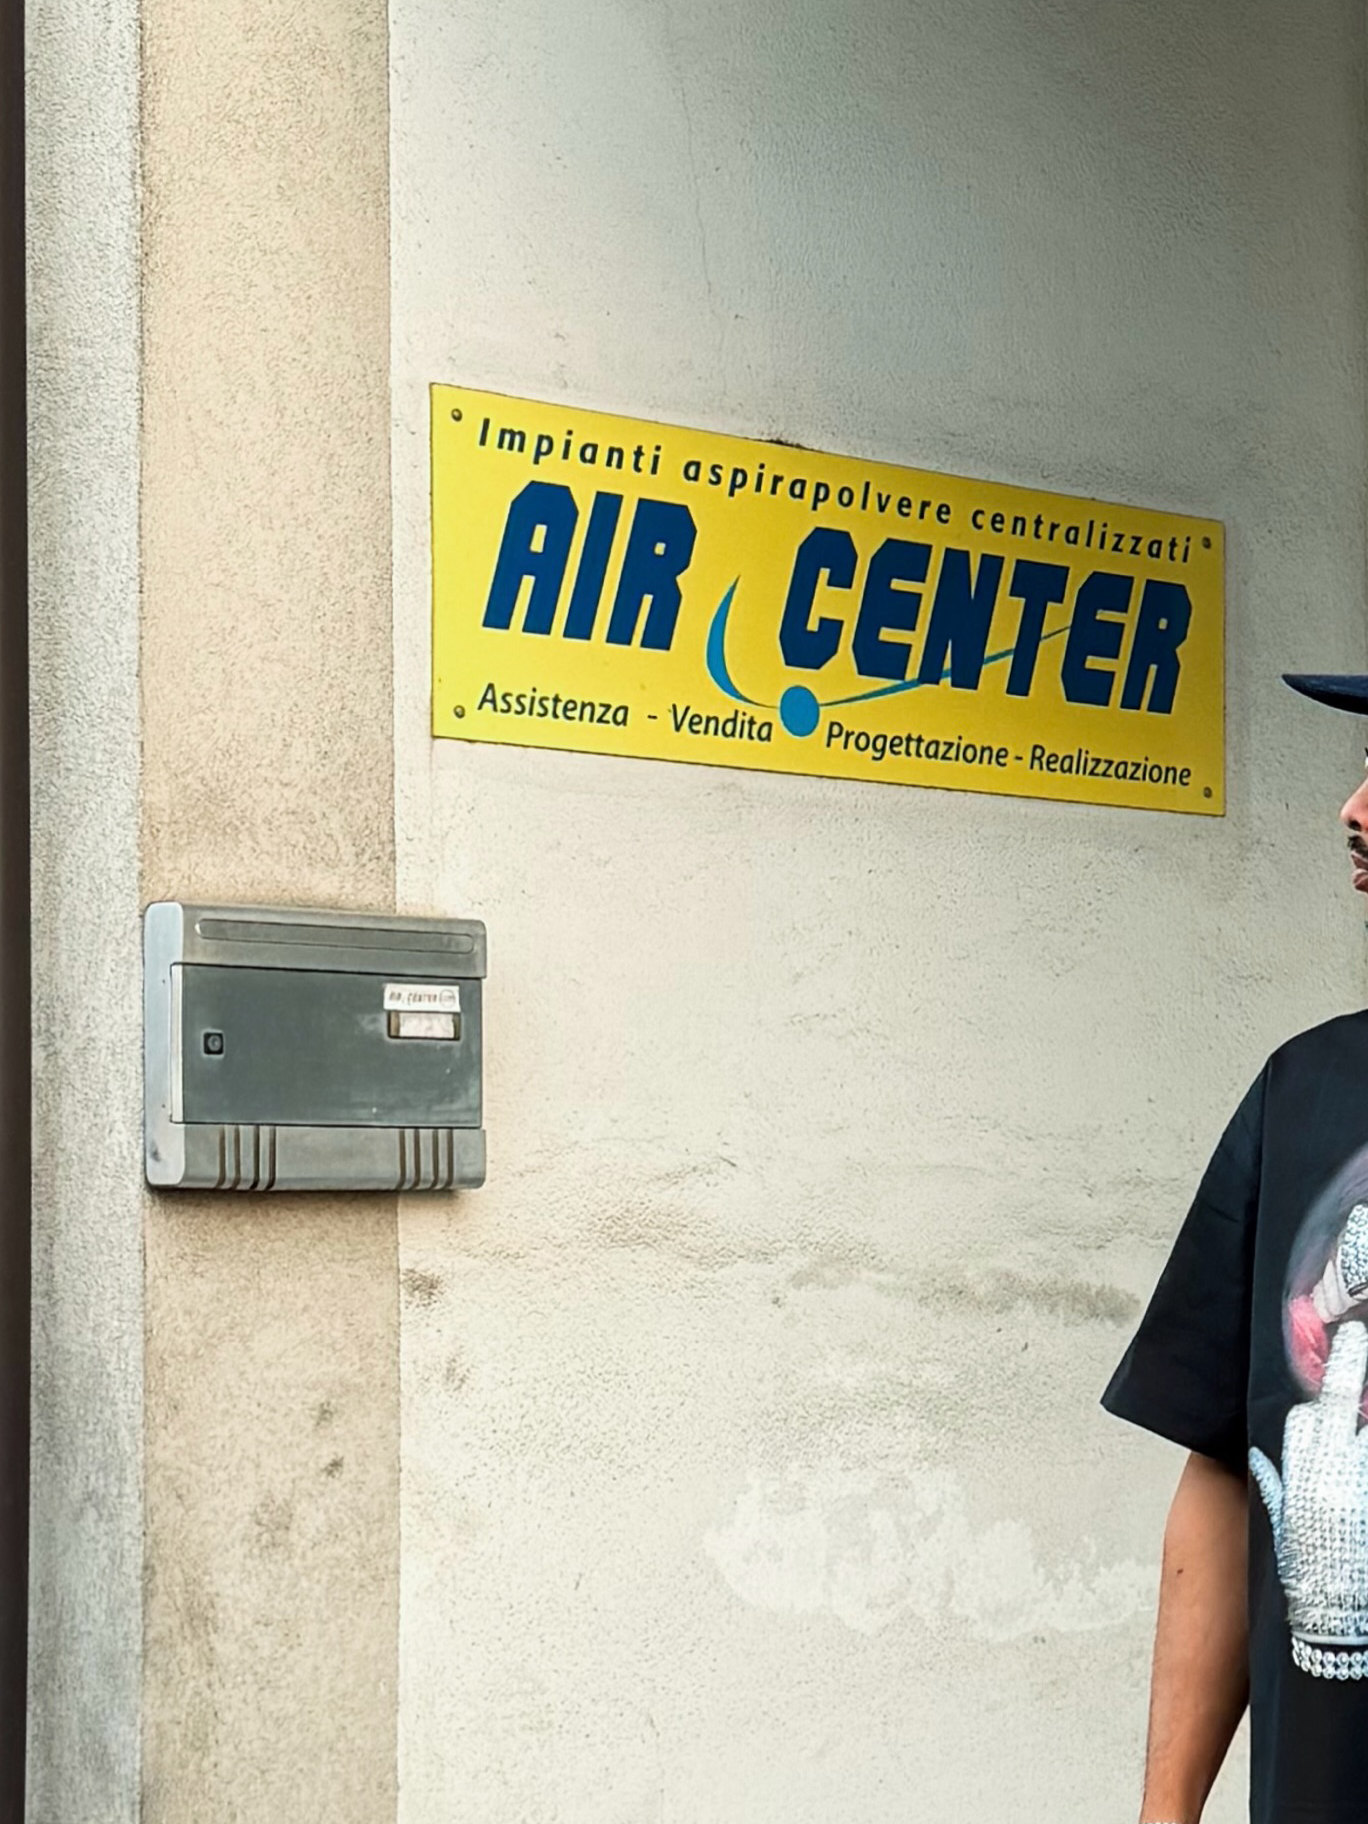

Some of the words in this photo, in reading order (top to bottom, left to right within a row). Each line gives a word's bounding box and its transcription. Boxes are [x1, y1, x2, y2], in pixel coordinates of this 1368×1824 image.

[479, 417, 661, 476] Impianti
[683, 460, 953, 526] aspirapolvere
[971, 509, 1193, 564] centralizzati
[482, 480, 698, 651] AIR
[778, 526, 1193, 716] CENTER
[477, 682, 630, 727] Assistenza
[671, 703, 774, 744] Vendita
[826, 721, 1010, 769] Progettazione
[1029, 744, 1193, 788] Realizzazione
